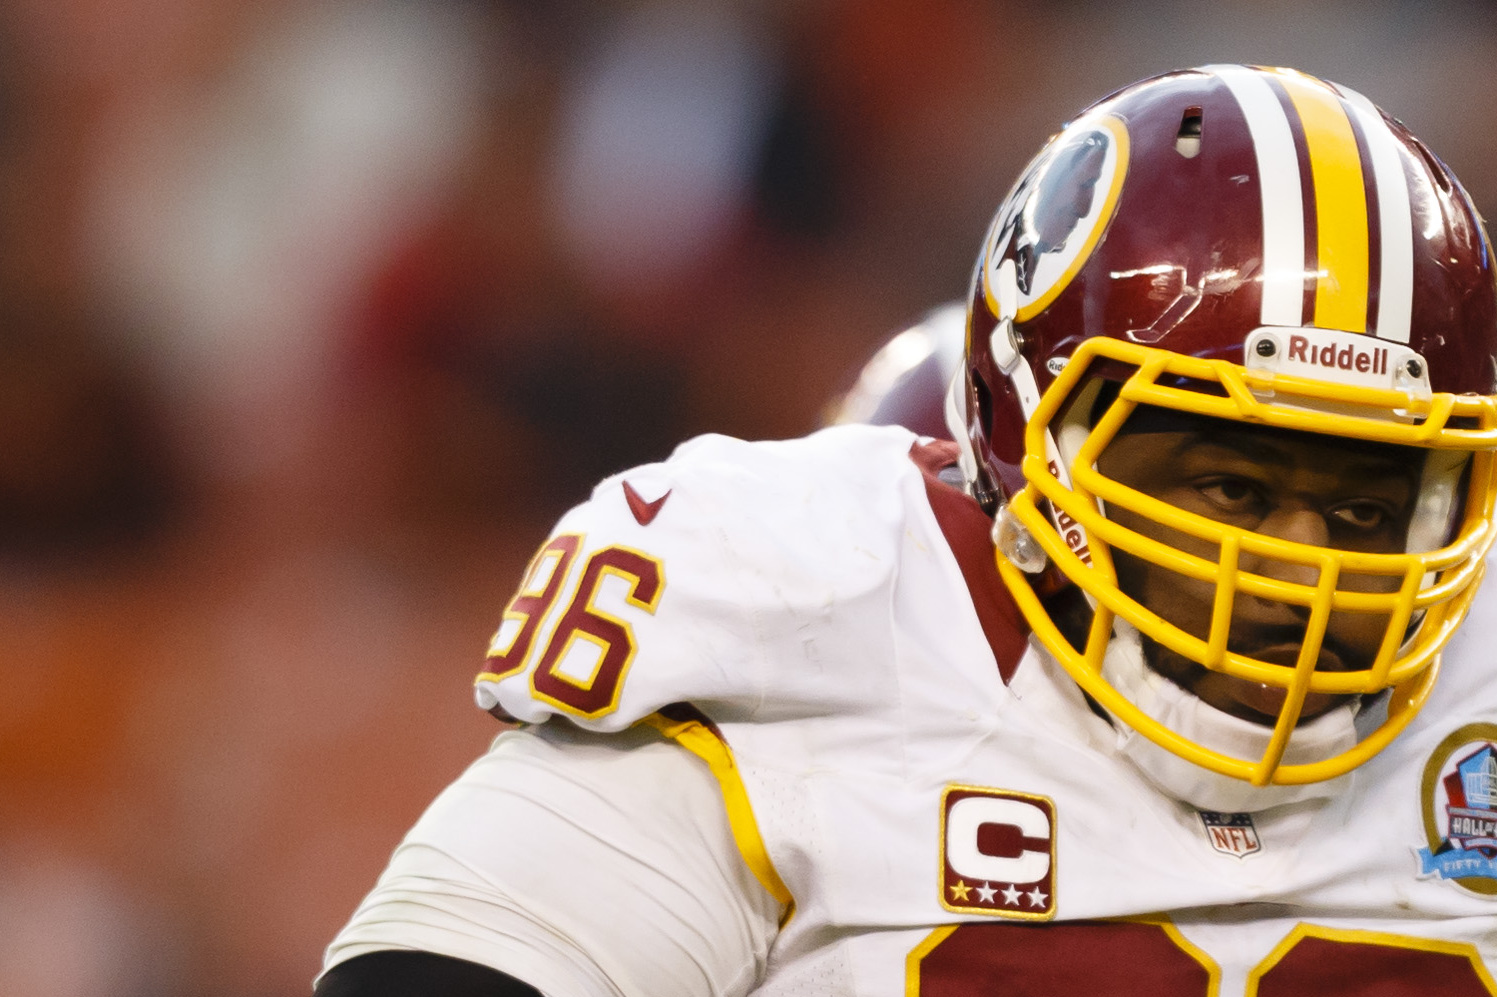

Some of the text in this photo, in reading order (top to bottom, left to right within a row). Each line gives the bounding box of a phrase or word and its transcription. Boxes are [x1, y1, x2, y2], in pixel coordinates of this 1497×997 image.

[1287, 334, 1389, 376] Riddell
[474, 532, 667, 720] 96
[946, 796, 1051, 884] C
[1210, 827, 1258, 852] NFL
[1453, 817, 1486, 836] HALL
[1444, 858, 1480, 873] FIFTY
